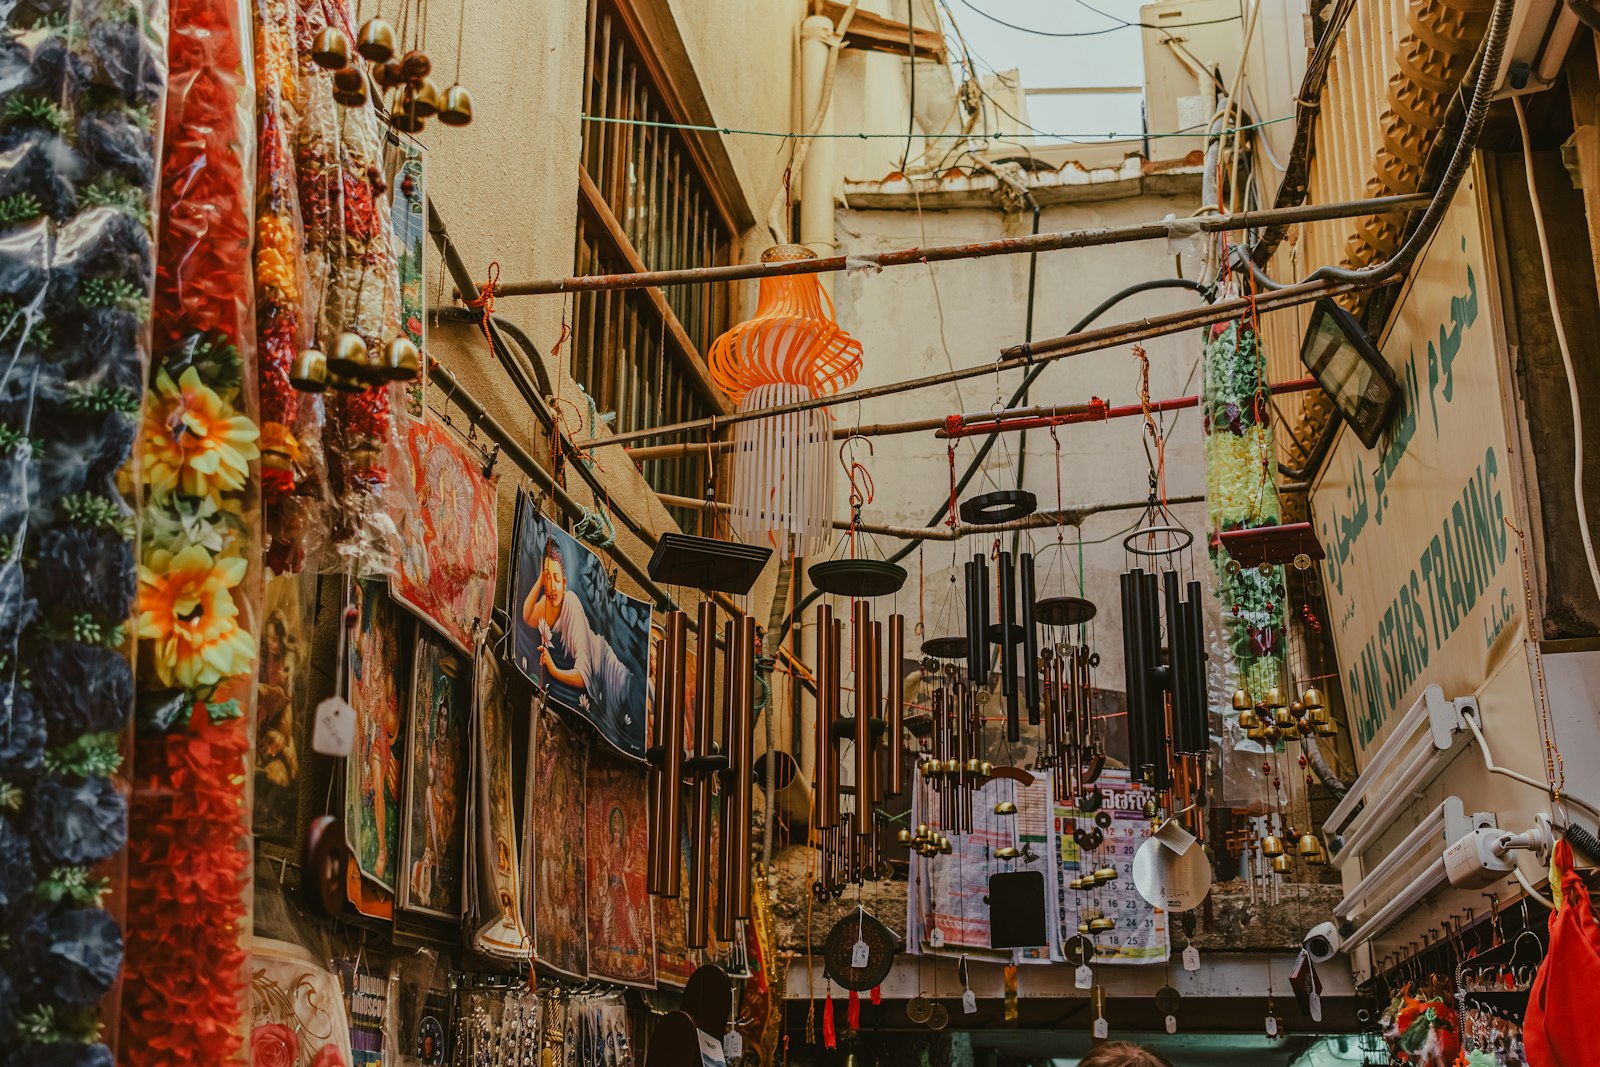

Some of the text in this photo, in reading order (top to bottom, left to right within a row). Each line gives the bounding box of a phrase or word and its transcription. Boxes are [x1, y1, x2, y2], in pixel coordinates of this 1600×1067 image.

[1349, 446, 1507, 752] CLAN STARS TRADING
[1105, 827, 1151, 838] 12 19 26
[1105, 845, 1134, 855] 13 20
[1107, 882, 1135, 891] 15 22
[1093, 898, 1100, 907] 9
[1108, 899, 1118, 908] 16
[1126, 900, 1136, 909] 23
[1126, 918, 1136, 927] 24
[1144, 919, 1154, 928] 31
[1109, 936, 1119, 945] 18
[1127, 936, 1138, 945] 25
[359, 973, 385, 997] DIAMON
